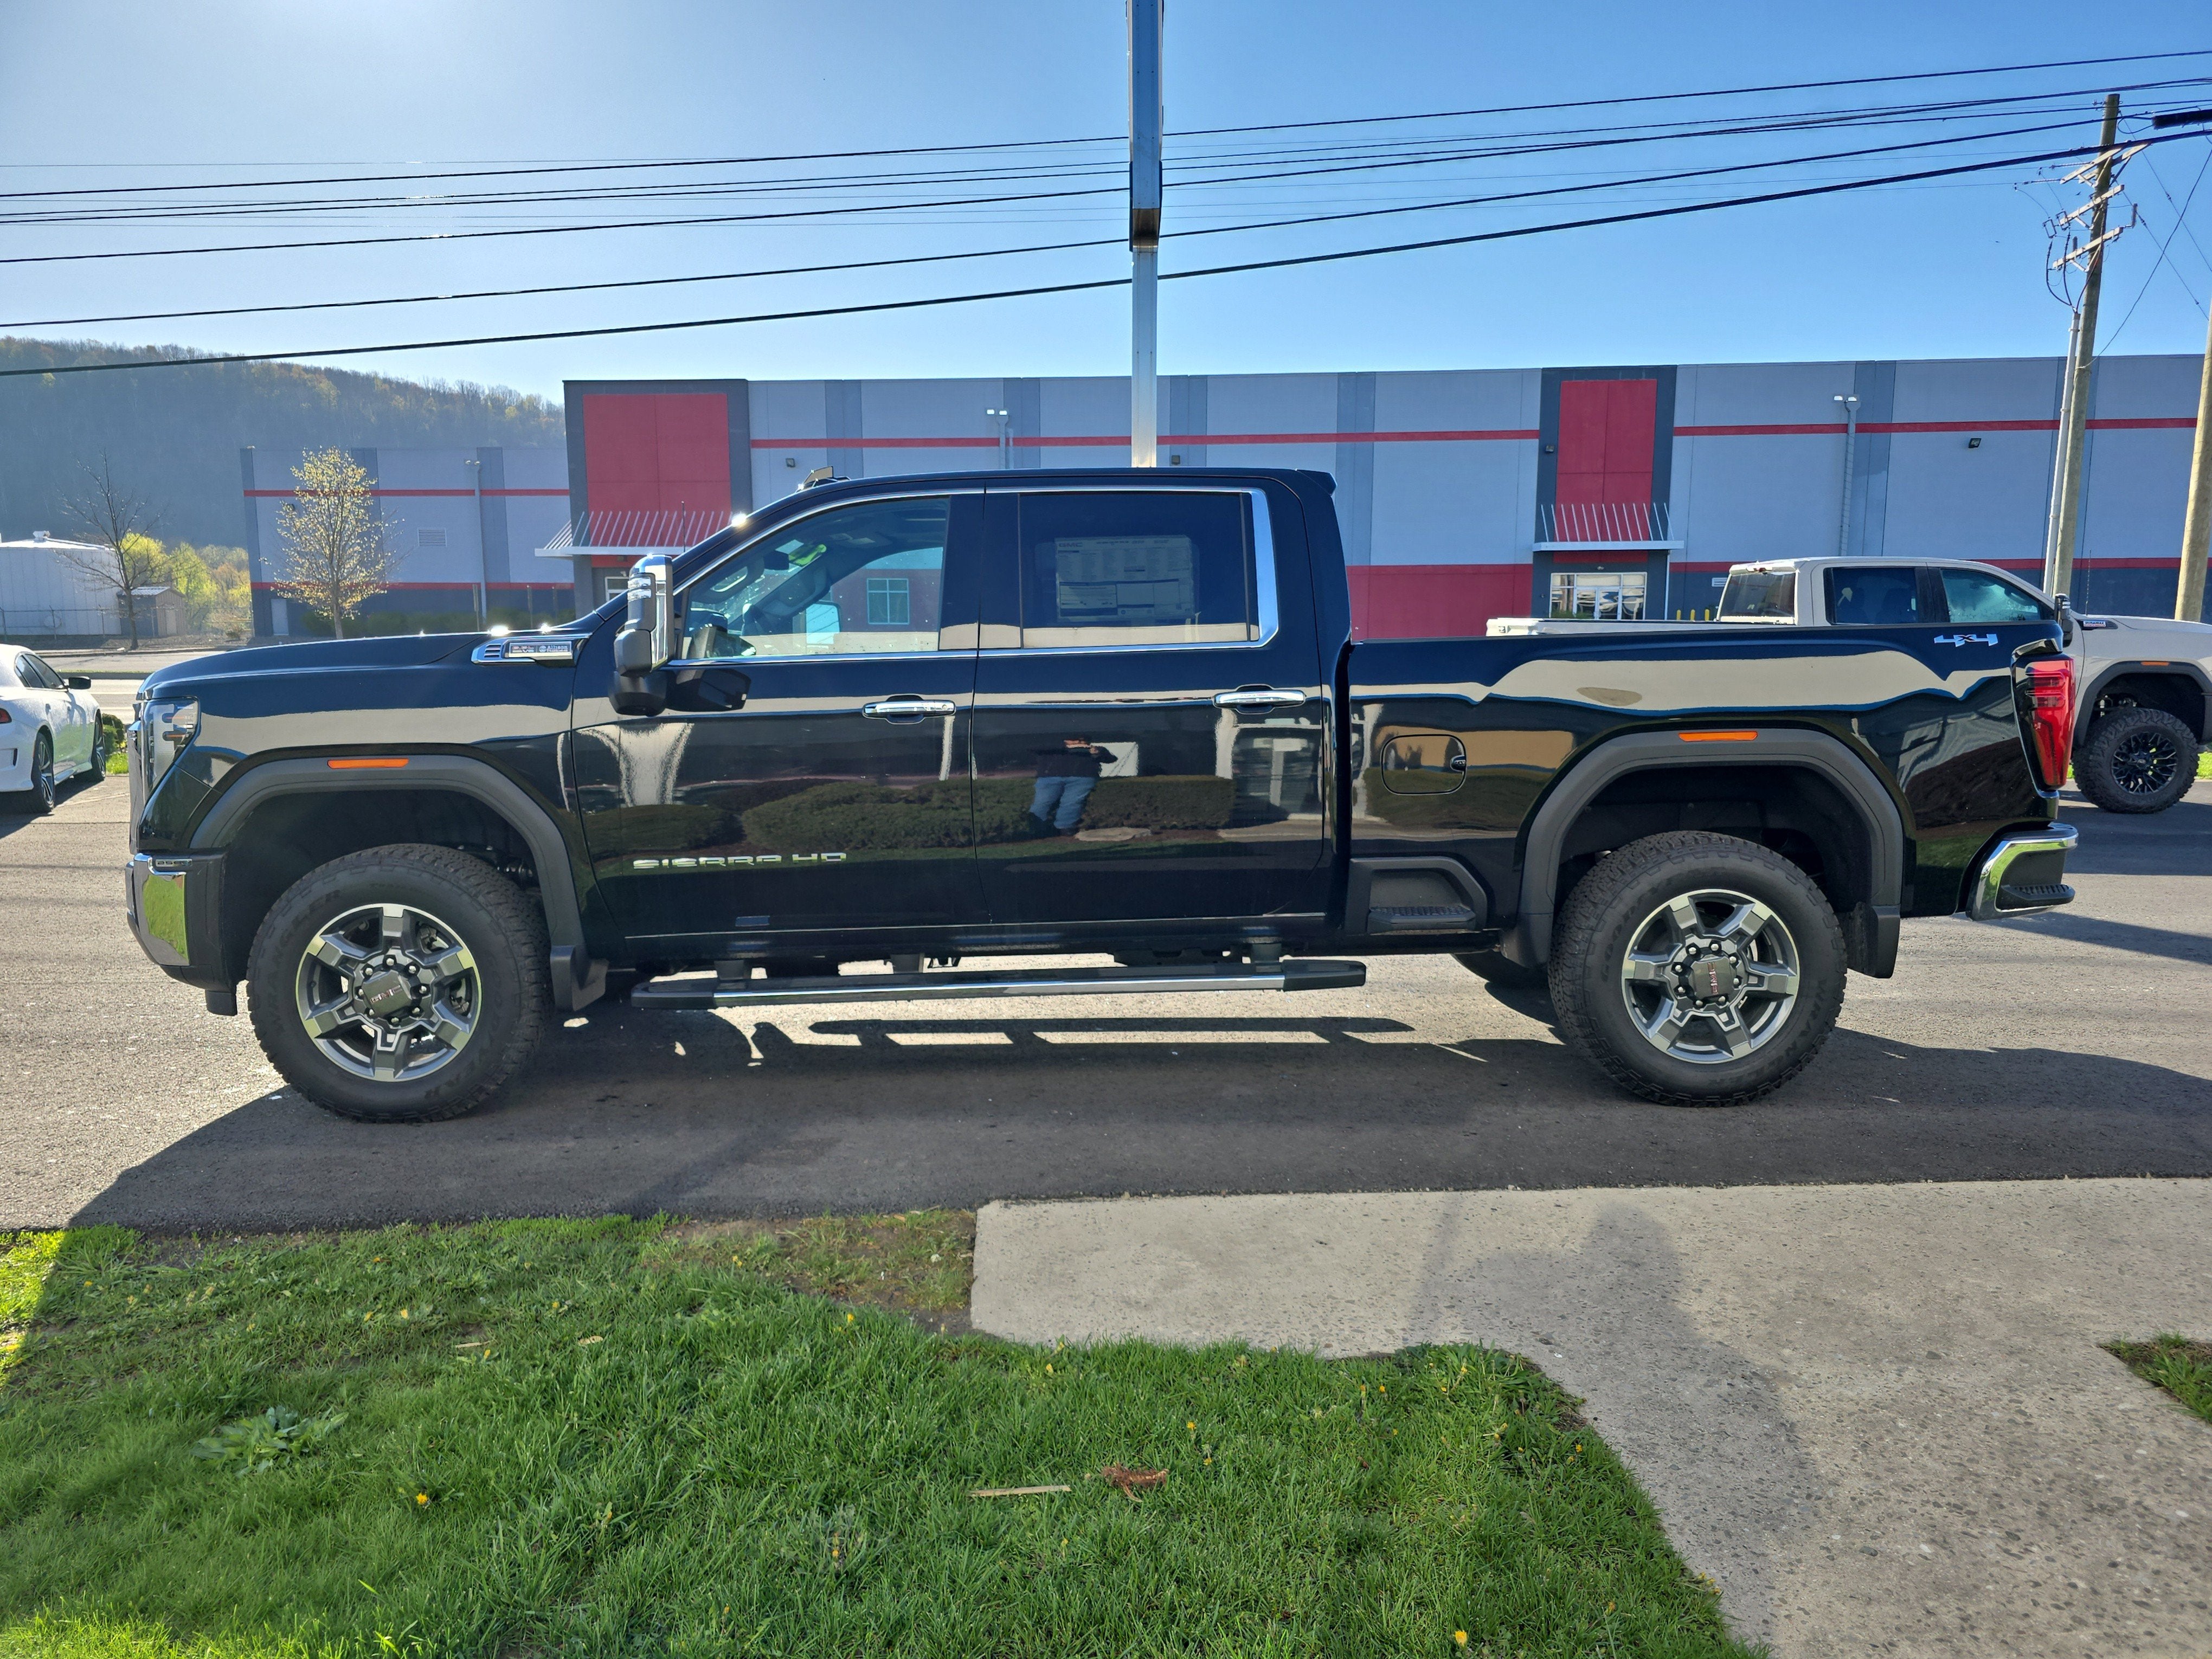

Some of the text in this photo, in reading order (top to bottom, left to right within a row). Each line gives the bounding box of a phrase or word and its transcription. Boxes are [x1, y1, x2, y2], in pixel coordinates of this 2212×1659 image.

[633, 852, 847, 869] SIERRA HD
[1707, 962, 1719, 995] GMC
[369, 984, 403, 1004] GMC
